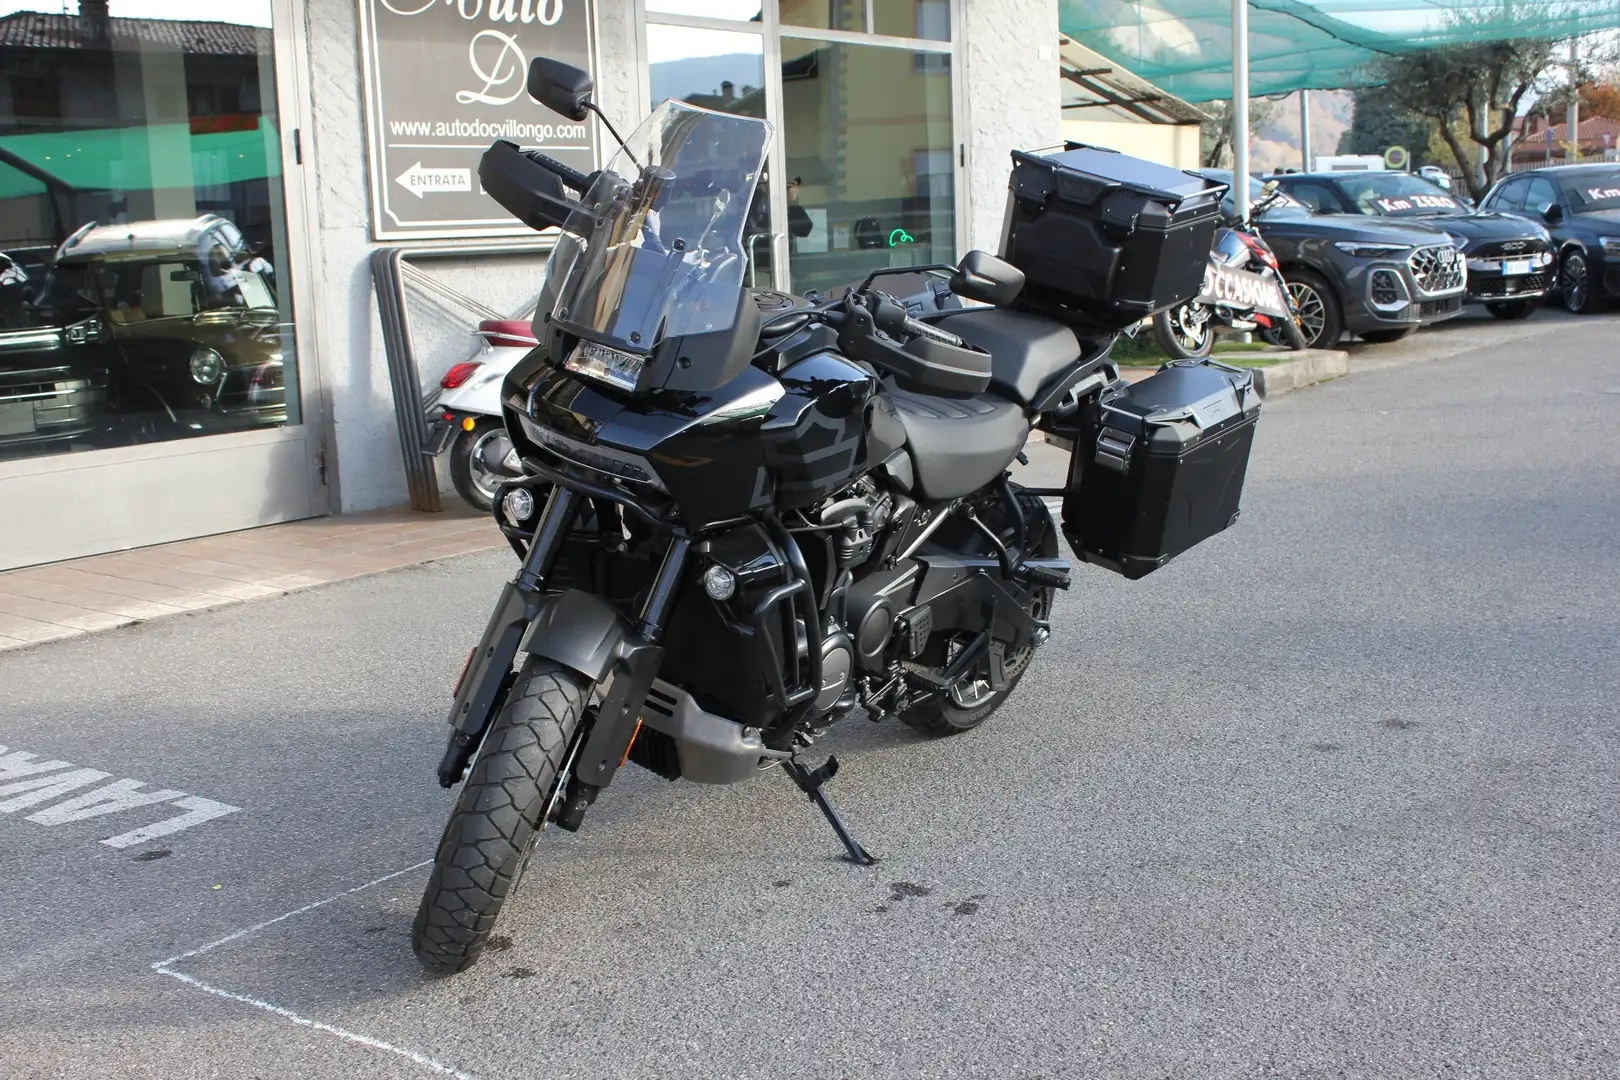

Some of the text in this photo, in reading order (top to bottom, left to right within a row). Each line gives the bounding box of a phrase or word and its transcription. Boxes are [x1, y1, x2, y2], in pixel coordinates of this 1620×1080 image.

[389, 119, 586, 142] www.autodocvillongo.com
[410, 174, 466, 187] ENTRATA
[1378, 195, 1456, 212] Km ZERO
